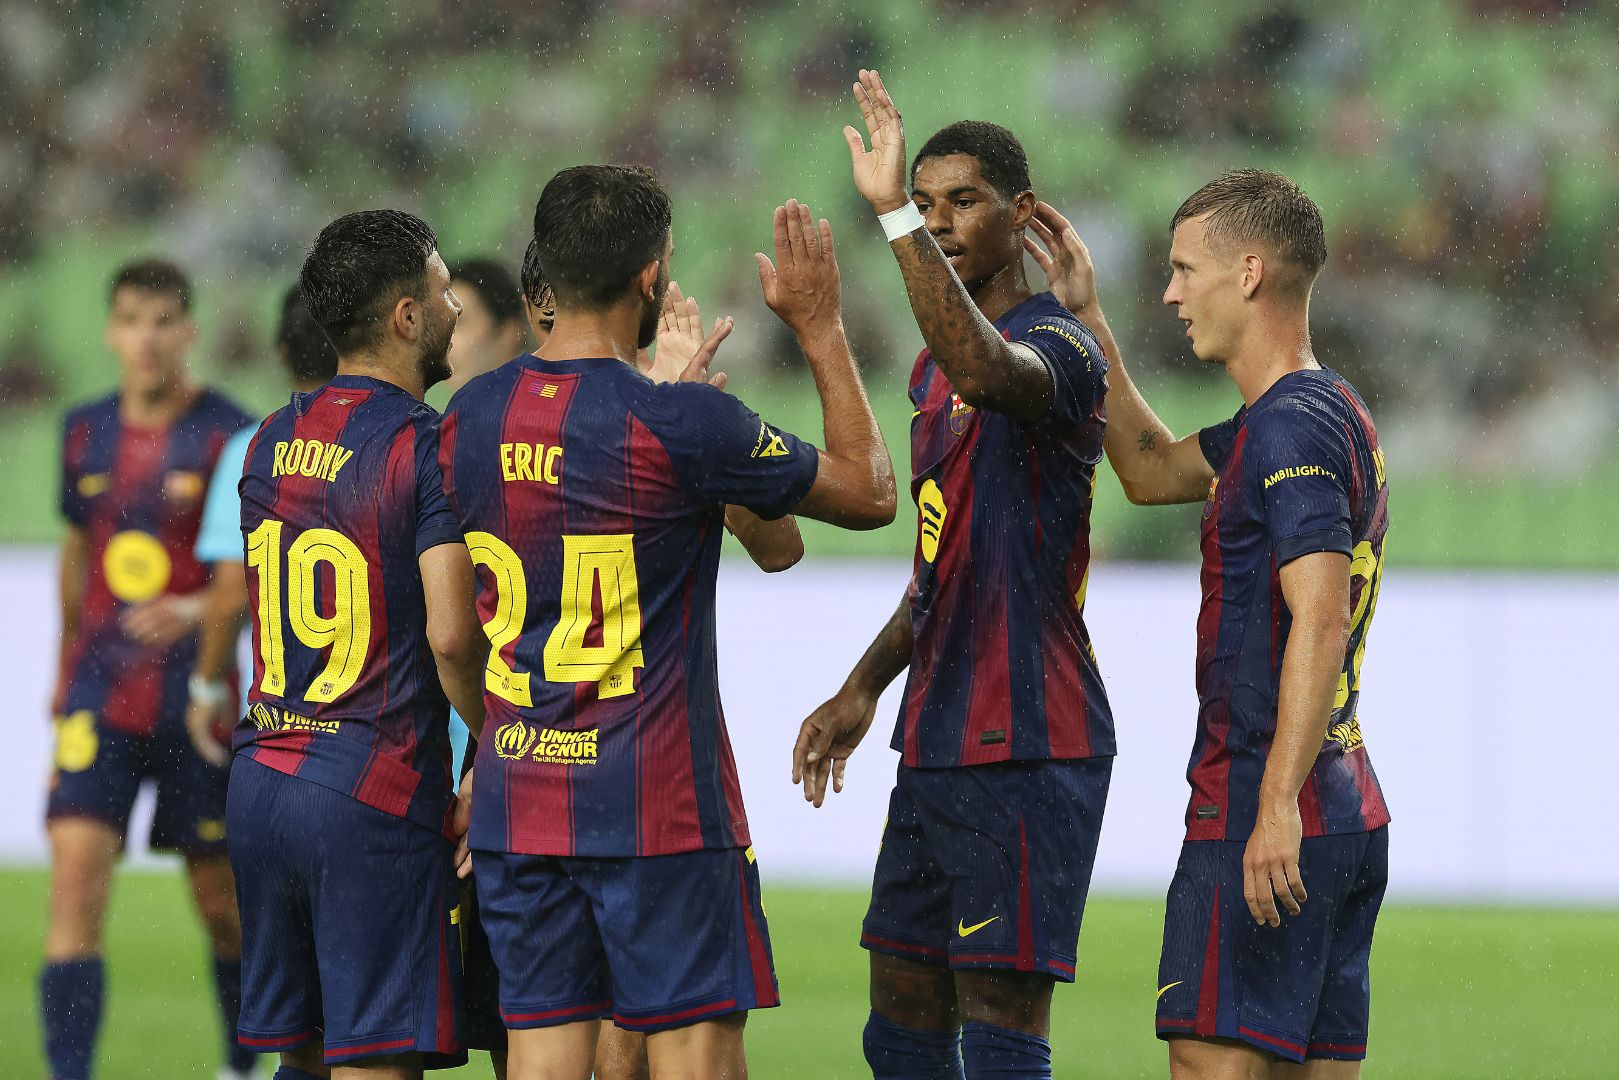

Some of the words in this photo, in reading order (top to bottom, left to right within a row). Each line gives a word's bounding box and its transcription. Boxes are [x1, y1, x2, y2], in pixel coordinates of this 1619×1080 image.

[500, 443, 564, 485] ERIC
[247, 518, 371, 704] 19
[464, 531, 645, 708] 24
[532, 742, 598, 758] ACNUR
[540, 728, 599, 743] UNHCR
